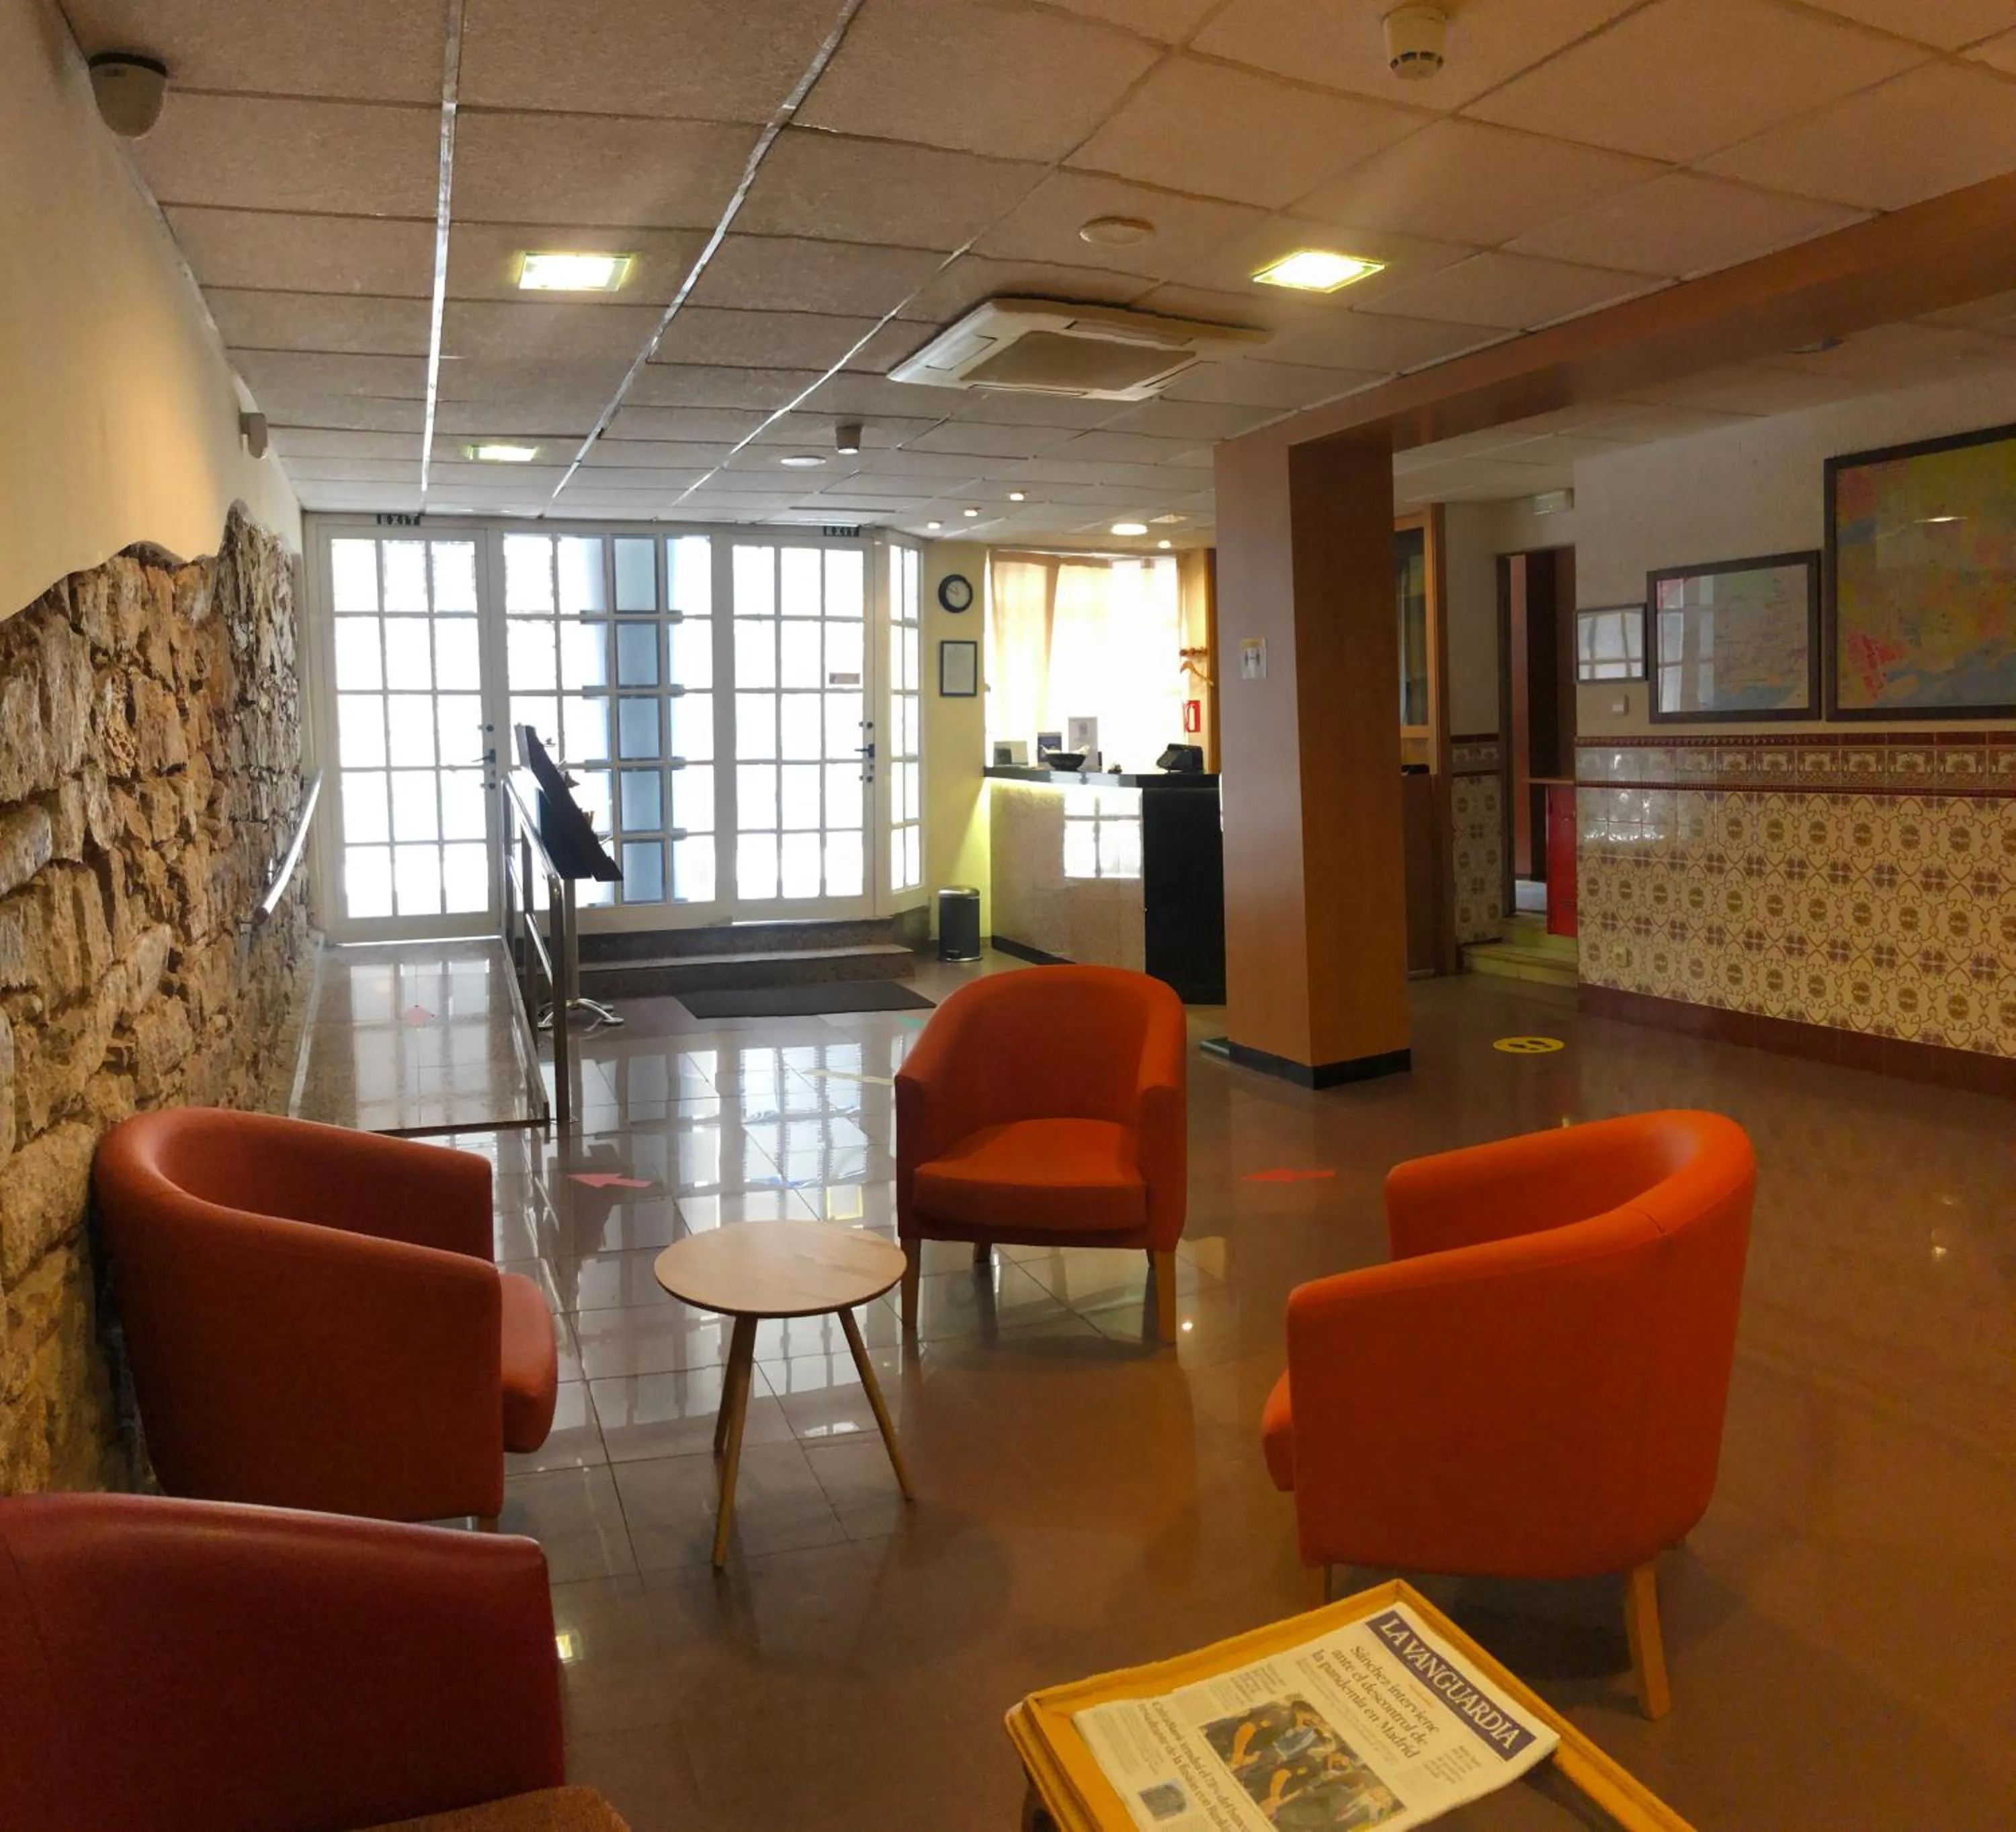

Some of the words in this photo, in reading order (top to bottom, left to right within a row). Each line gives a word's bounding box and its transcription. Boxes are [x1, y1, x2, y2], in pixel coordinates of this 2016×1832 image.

[1311, 1649, 1325, 1663] la
[1316, 1661, 1367, 1708] pandemia
[1331, 1649, 1356, 1672] ante
[1351, 1672, 1370, 1681] el
[1361, 1682, 1419, 1732] descontrol
[1410, 1732, 1428, 1745] de
[1349, 1645, 1392, 1685] Sánchez
[1387, 1684, 1440, 1733] interviene
[1381, 1618, 1409, 1647] LA
[1402, 1638, 1520, 1749] VANGUARDIA
[1363, 1708, 1380, 1722] en
[1380, 1720, 1421, 1759] Madrid
